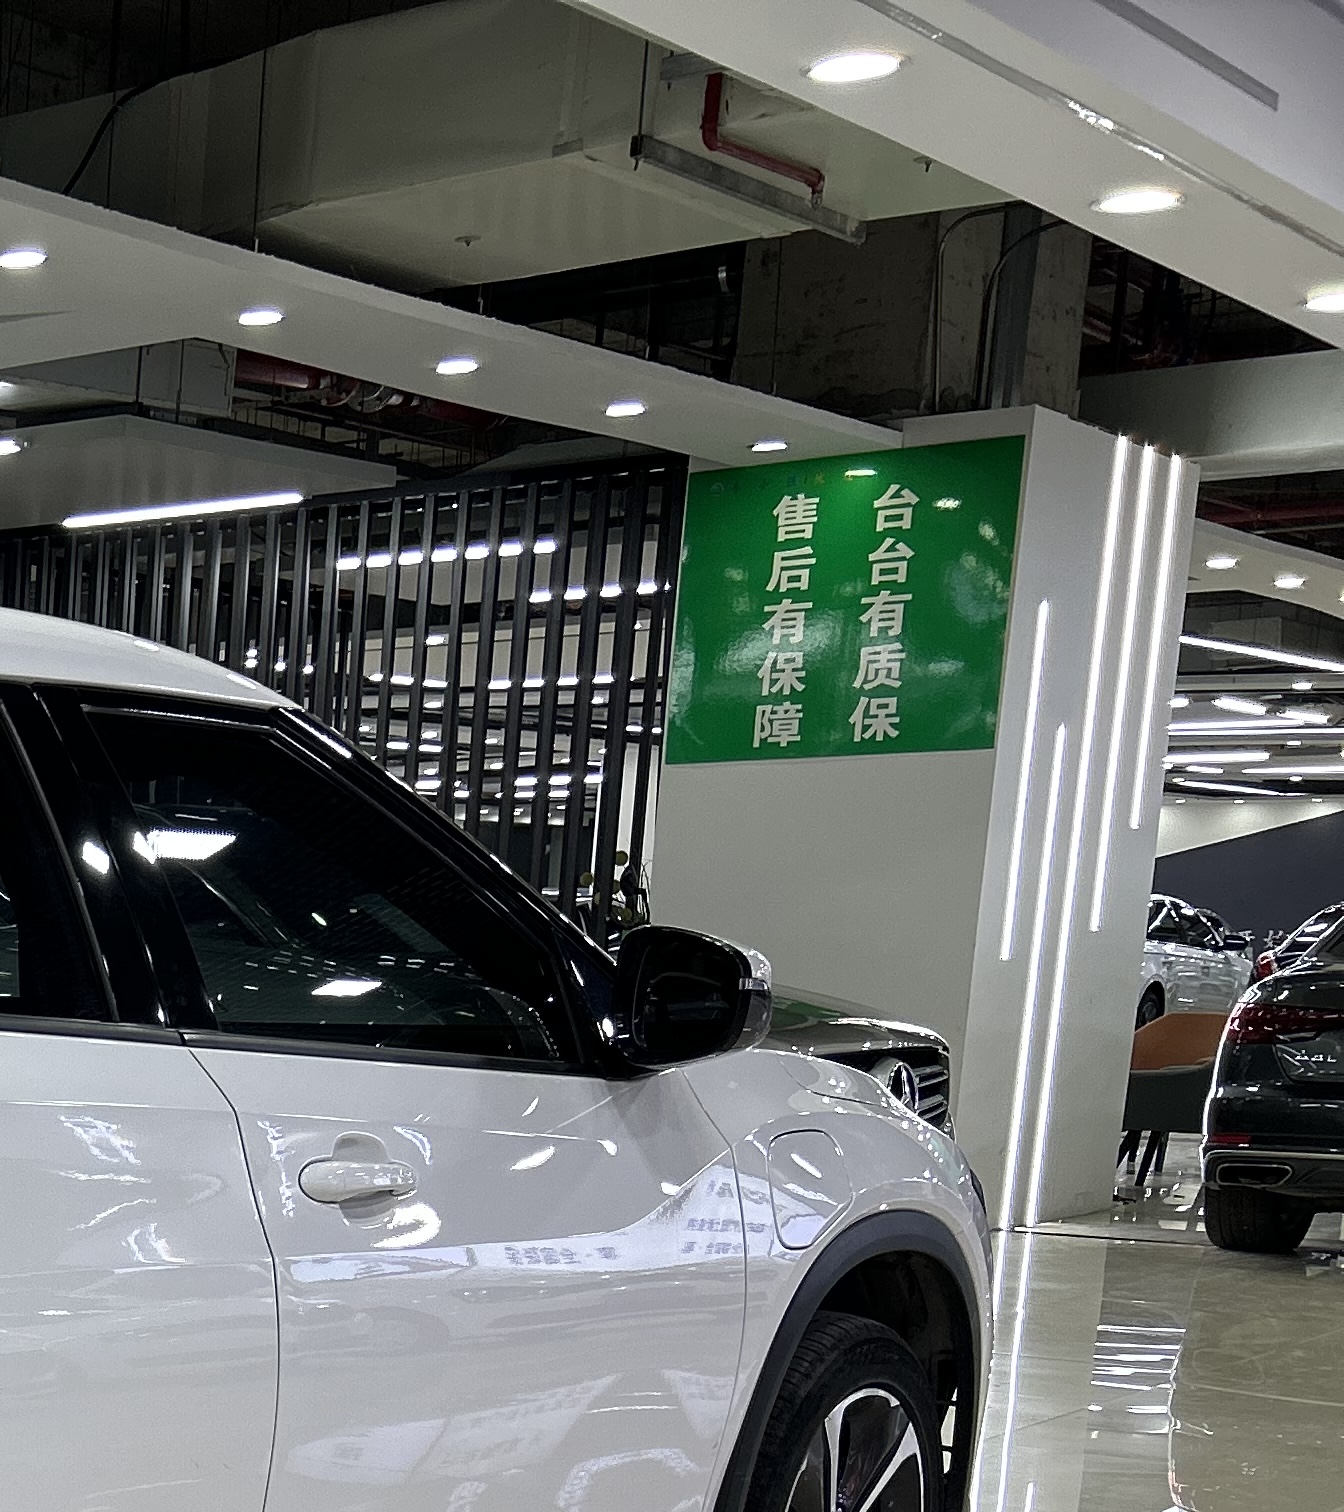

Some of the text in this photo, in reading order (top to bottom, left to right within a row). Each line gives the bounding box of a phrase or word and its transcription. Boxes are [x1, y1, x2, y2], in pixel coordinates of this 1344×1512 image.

[753, 493, 820, 748] 售后有保障
[847, 484, 920, 742] 台台有质保
